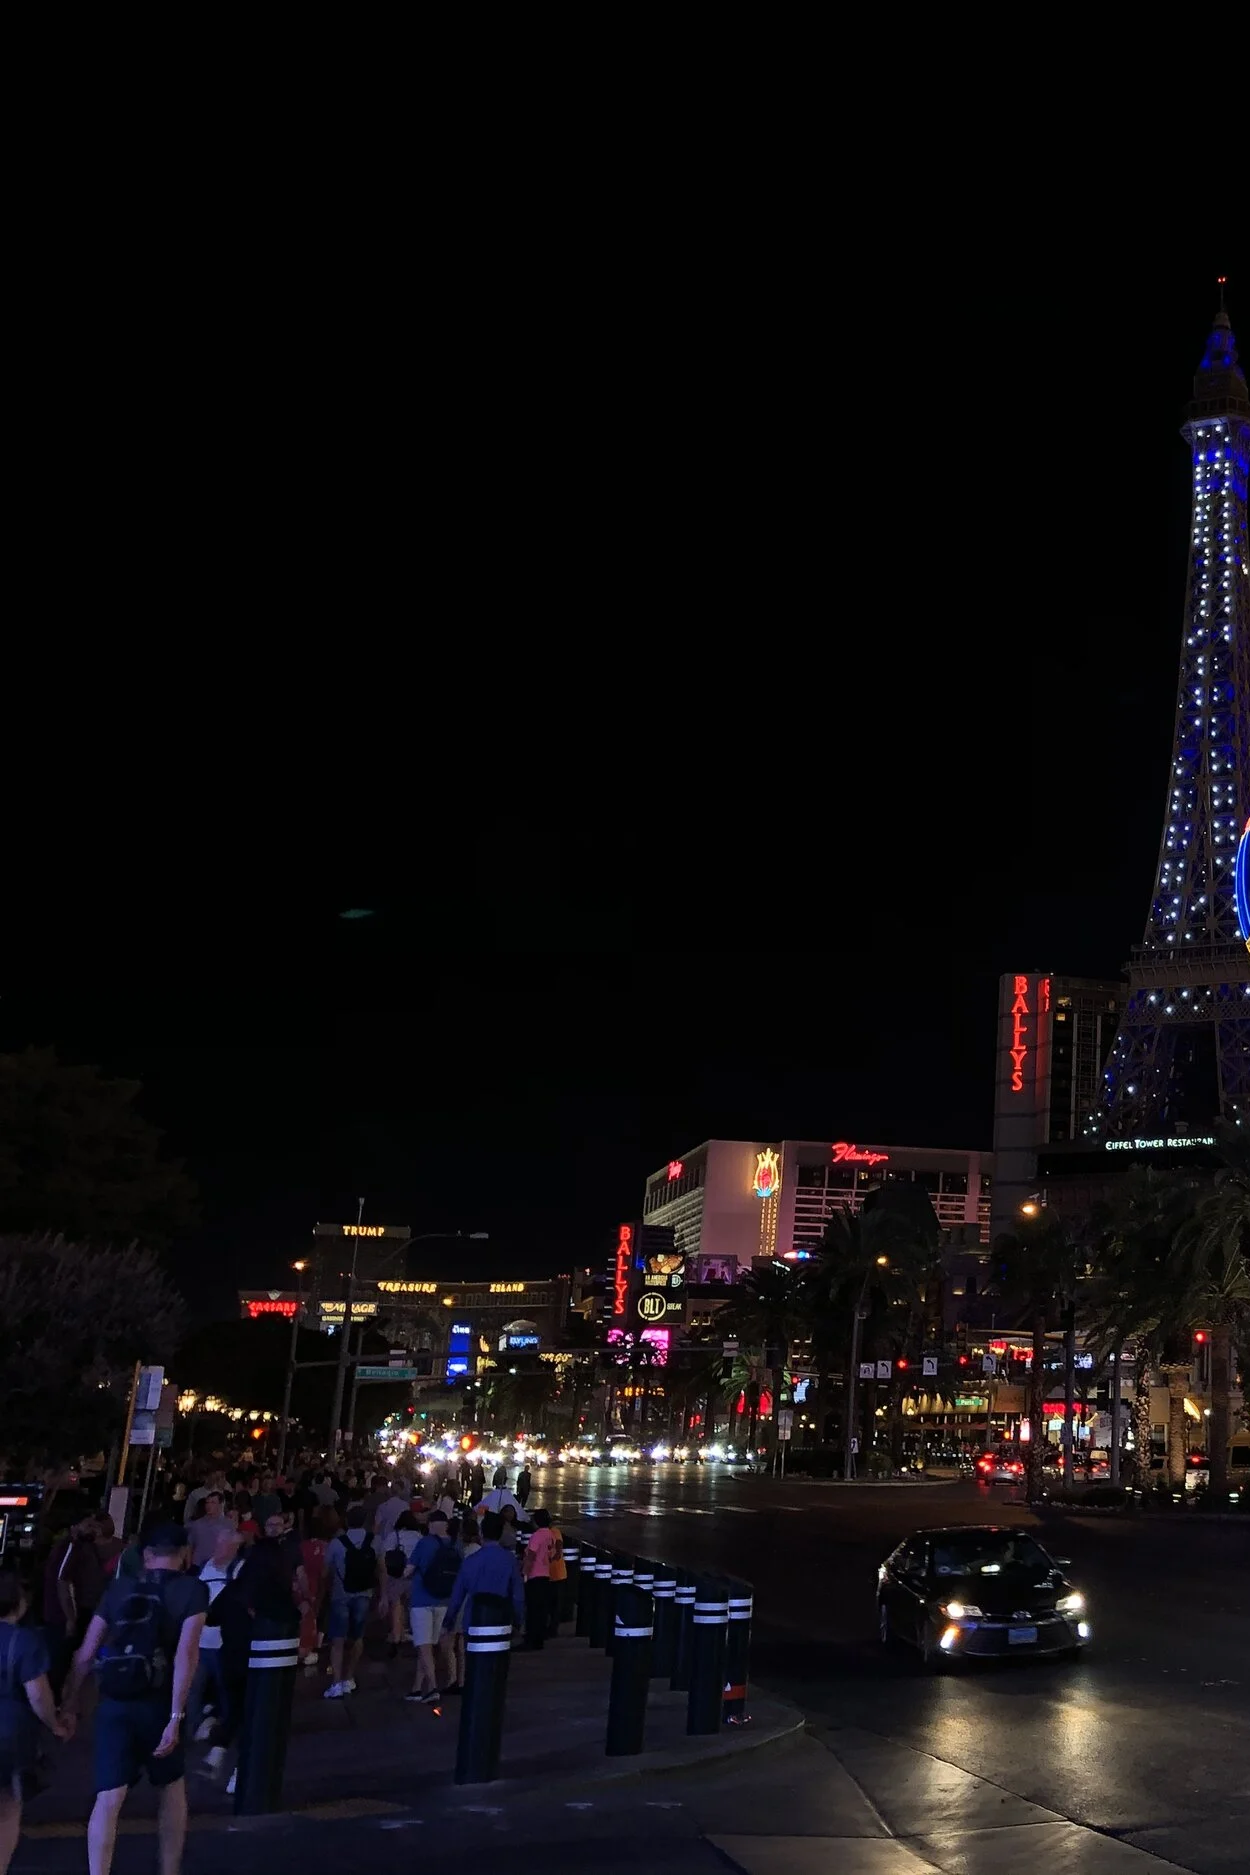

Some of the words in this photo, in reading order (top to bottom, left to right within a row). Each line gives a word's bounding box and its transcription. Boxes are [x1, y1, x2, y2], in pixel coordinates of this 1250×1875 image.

[1105, 1140, 1133, 1150] EIFFEL
[1134, 1139, 1164, 1149] TOWER
[1167, 1137, 1216, 1147] RESTAUAN
[831, 1142, 889, 1166] Flamingo
[342, 1225, 385, 1237] TRUMP
[377, 1281, 437, 1294] TREASURE
[489, 1283, 525, 1293] ISLAND
[248, 1301, 297, 1312] CAESARS
[643, 1298, 661, 1315] BLT
